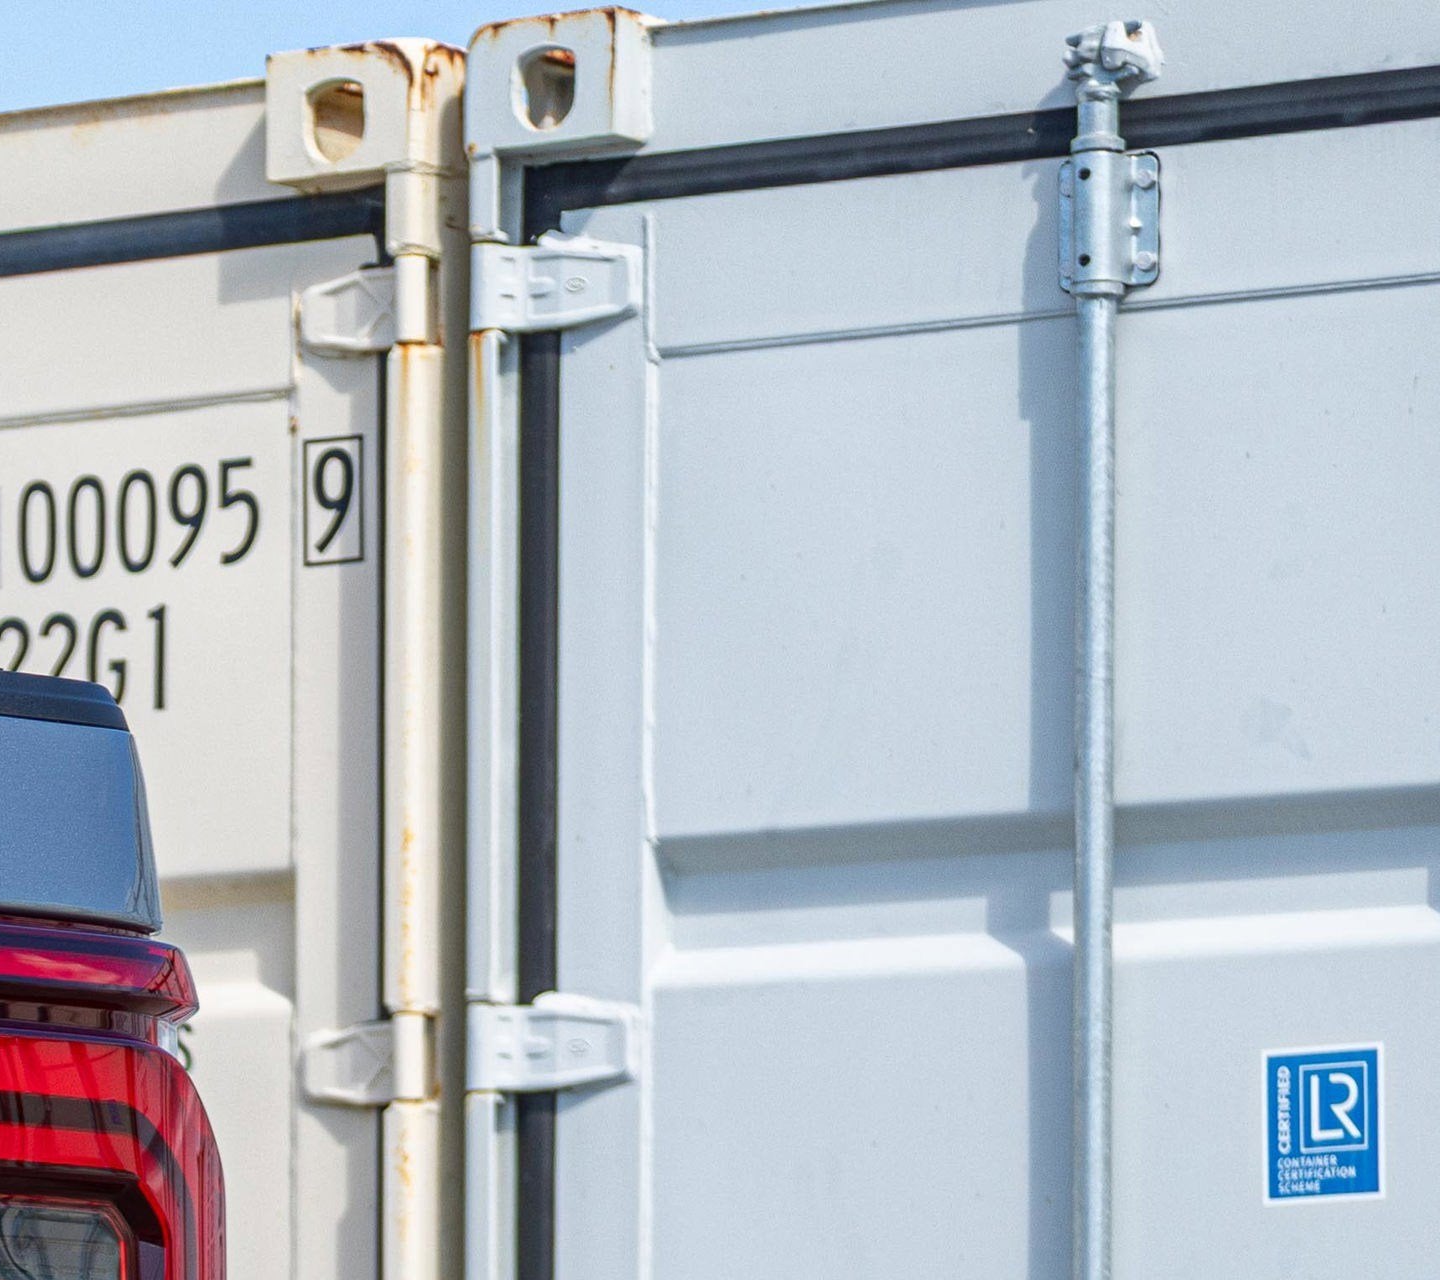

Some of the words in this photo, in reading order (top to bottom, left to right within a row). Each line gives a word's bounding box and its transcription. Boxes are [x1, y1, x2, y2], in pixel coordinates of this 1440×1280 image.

[314, 447, 356, 554] 9
[1277, 1065, 1291, 1155] CERTIFIED
[1310, 1072, 1362, 1142] LR
[1277, 1154, 1338, 1170] CONTAINER
[1277, 1165, 1357, 1181] CERTIFICATION
[1278, 1180, 1321, 1195] SCHEME
